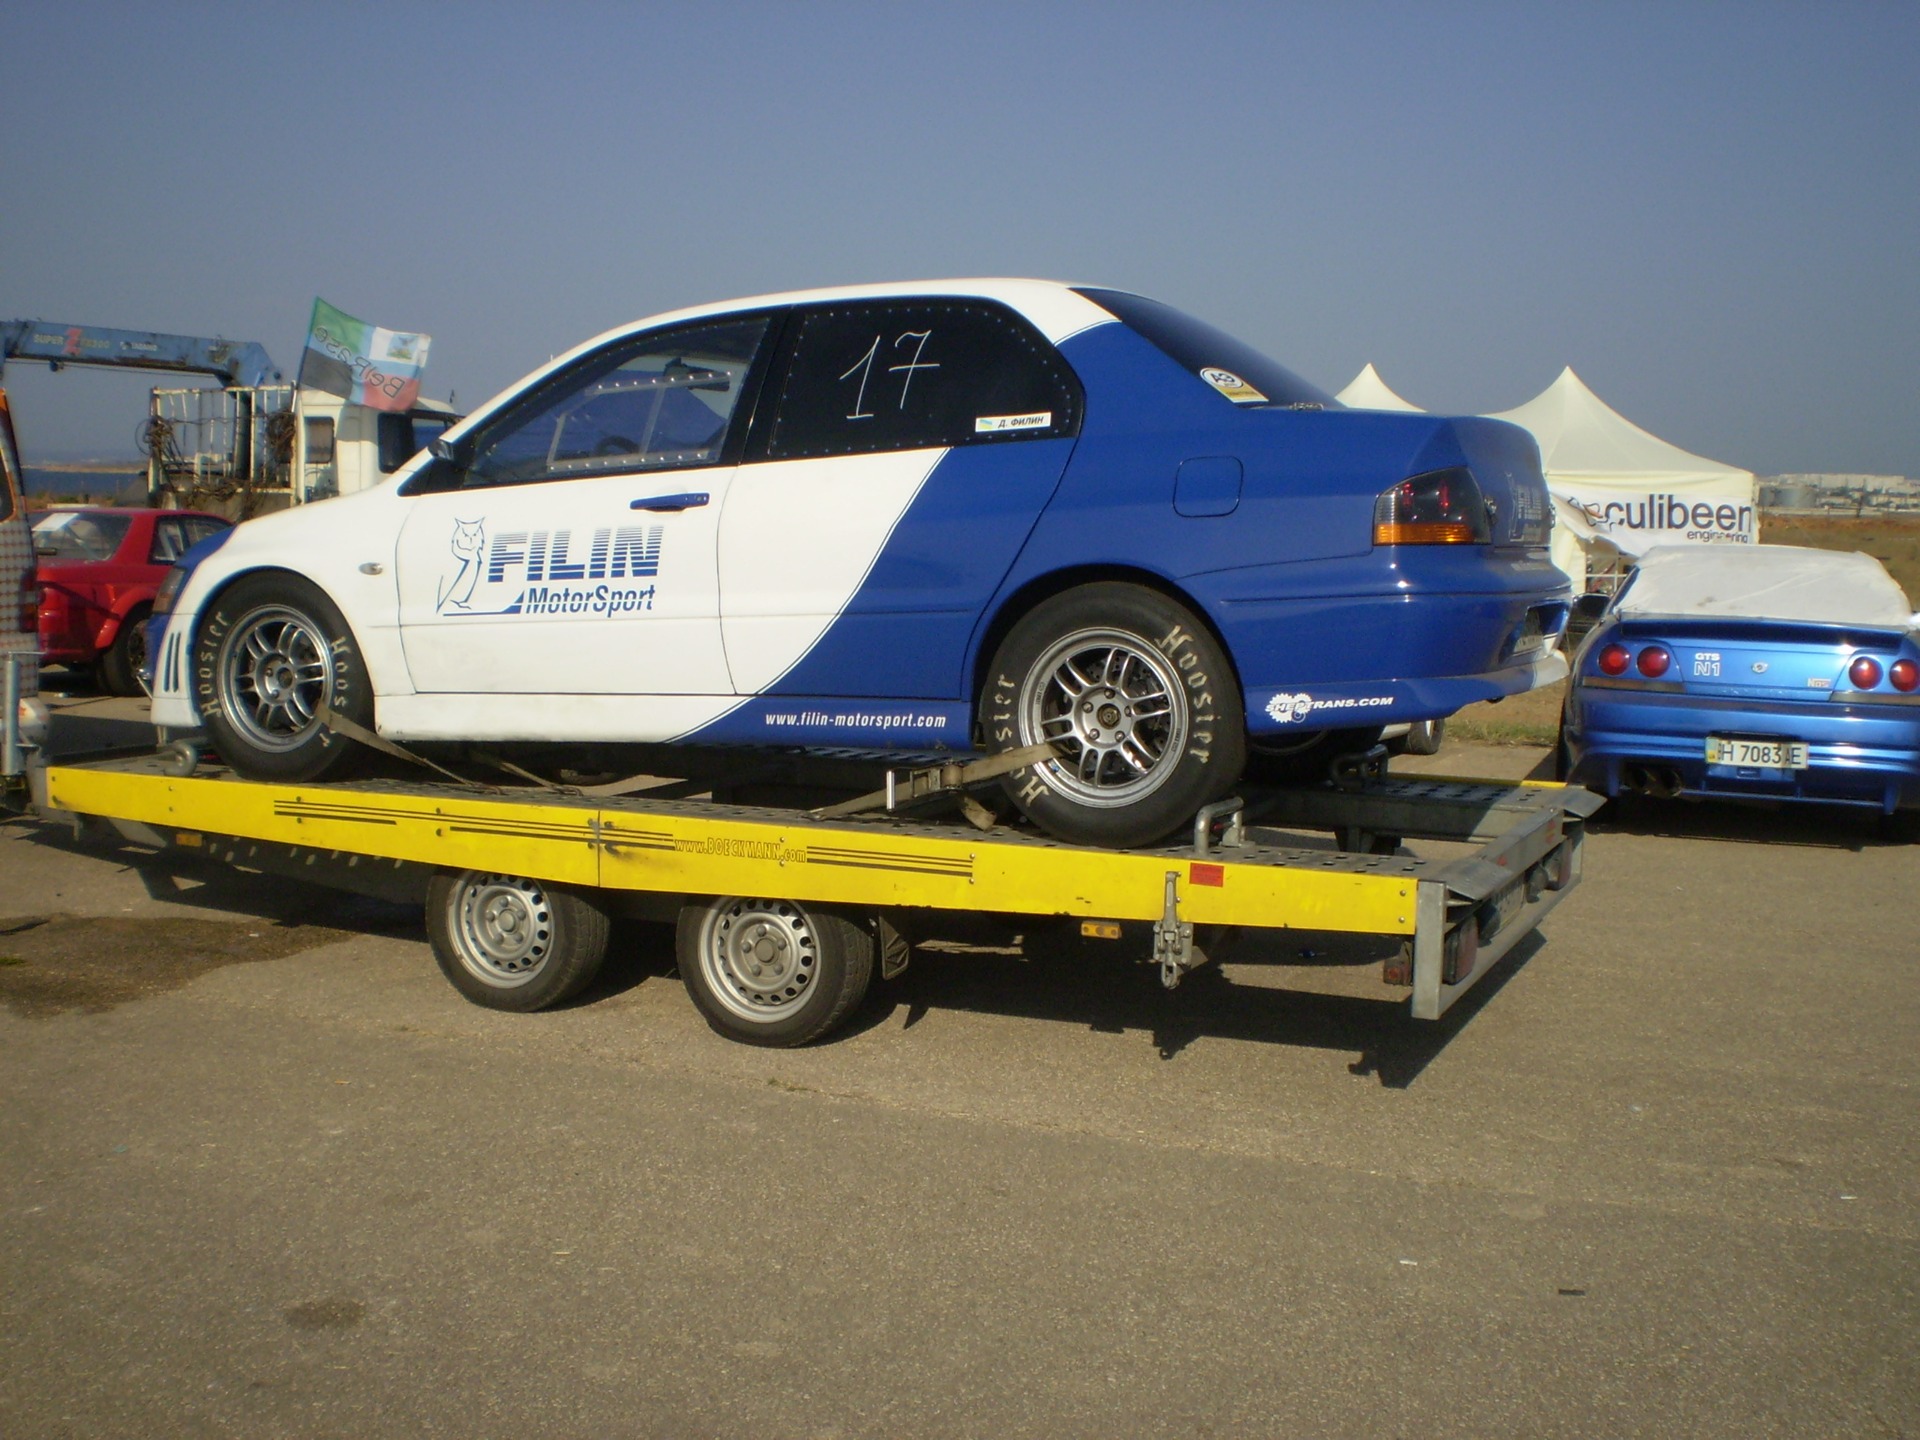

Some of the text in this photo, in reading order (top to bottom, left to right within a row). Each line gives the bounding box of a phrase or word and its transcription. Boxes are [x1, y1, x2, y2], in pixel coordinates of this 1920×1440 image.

[838, 329, 941, 420] 17
[1011, 416, 1045, 427] ФИЛИН
[487, 526, 664, 583] FILIN
[525, 584, 656, 618] MotorSport
[1693, 661, 1721, 677] N1
[1695, 652, 1721, 662] GTS
[318, 635, 349, 748] Hoosr
[1154, 624, 1221, 765] Hoosier
[765, 711, 947, 730] www.filin-motorsport.com
[991, 673, 1050, 807] Hsier
[1741, 745, 1782, 764] 7083
[674, 837, 806, 863] www.BOECKMANN.com
